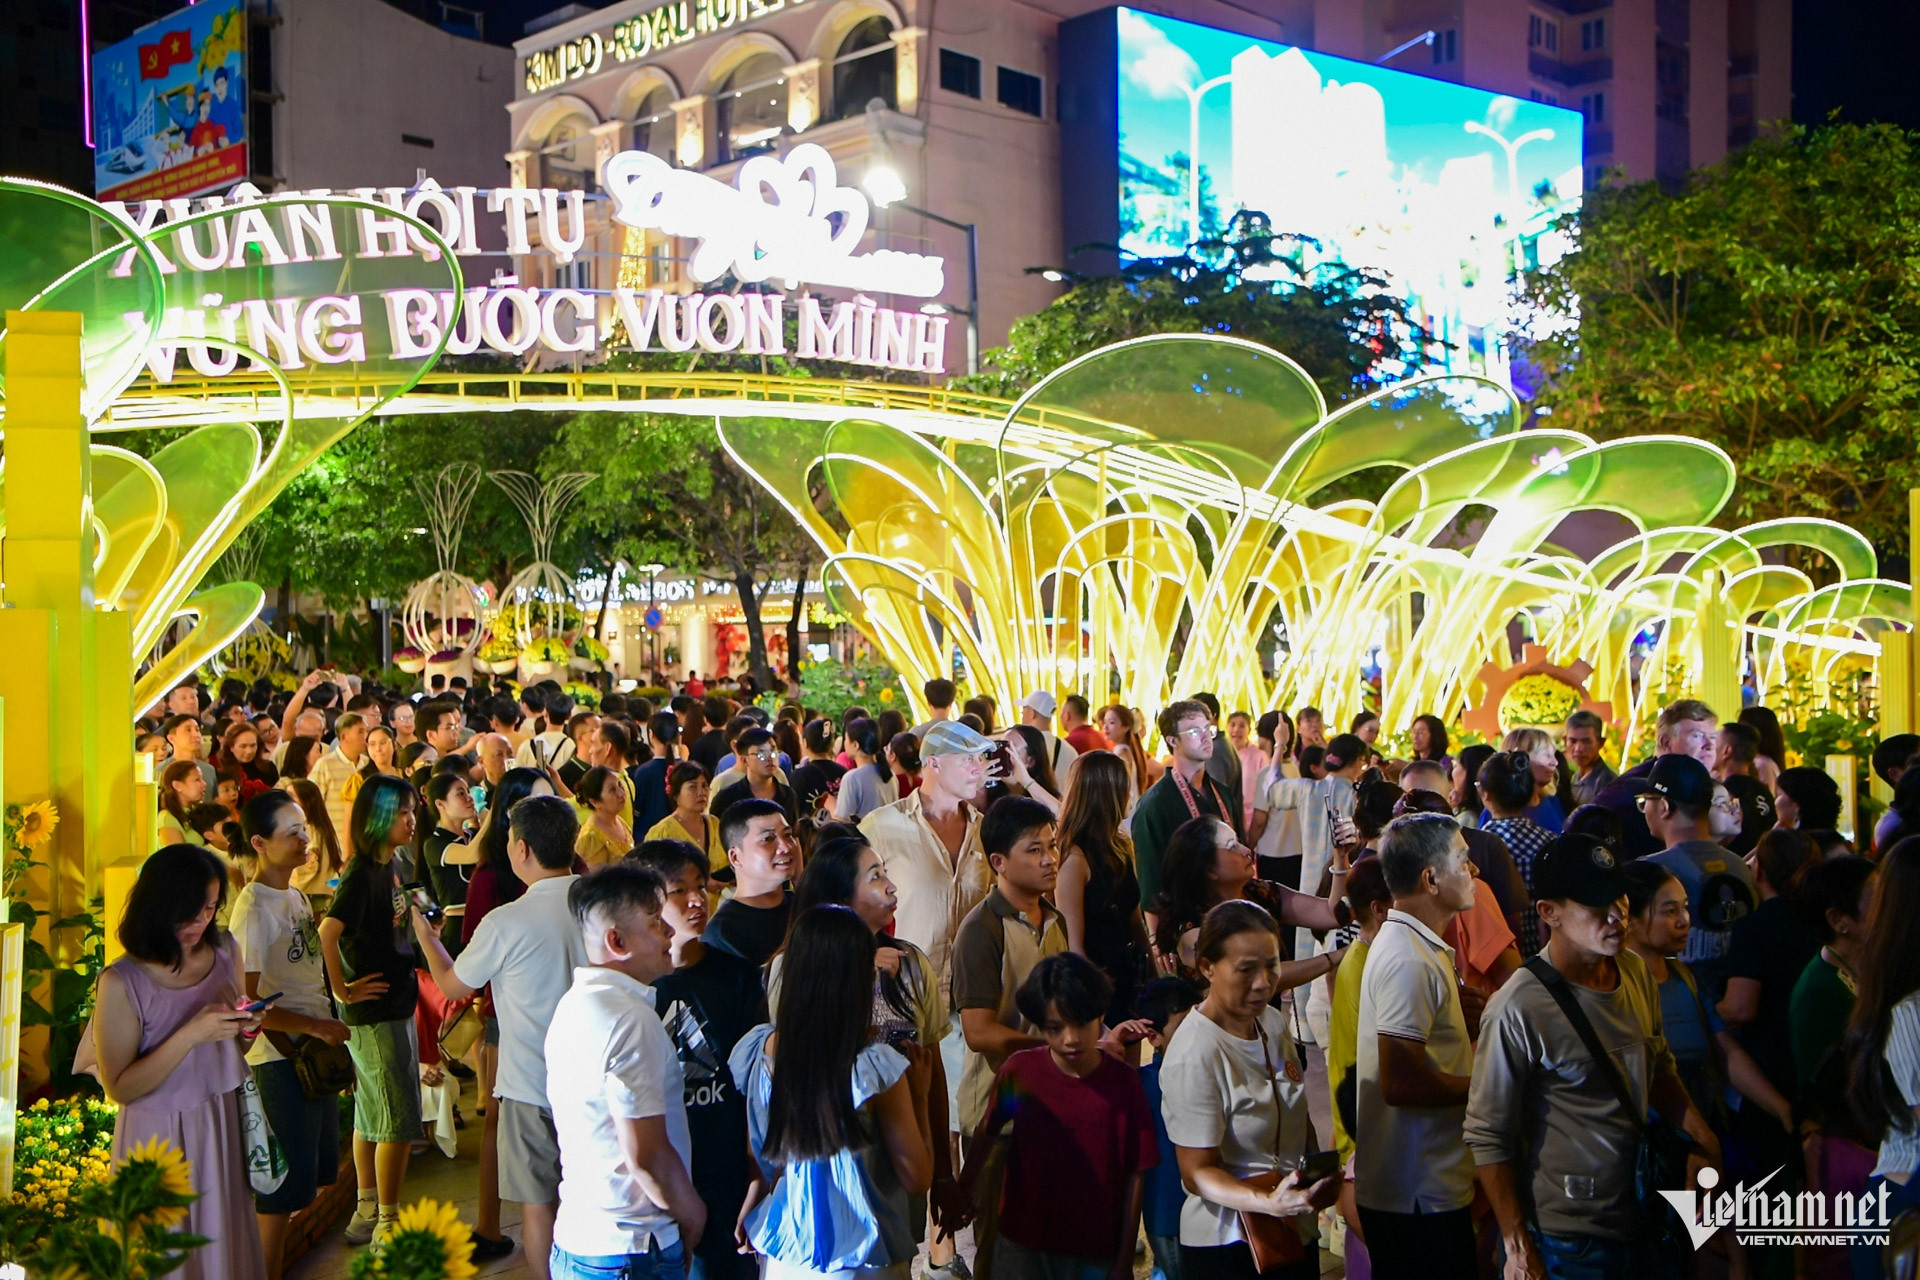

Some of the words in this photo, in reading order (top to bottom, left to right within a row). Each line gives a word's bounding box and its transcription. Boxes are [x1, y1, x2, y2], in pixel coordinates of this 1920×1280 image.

[614, 1, 696, 63] ROYAL
[101, 182, 342, 276] XUÂN
[355, 177, 481, 261] HỘI
[487, 188, 585, 262] TỤ
[614, 288, 787, 355] VƯƠN
[795, 292, 949, 374] MÌNH
